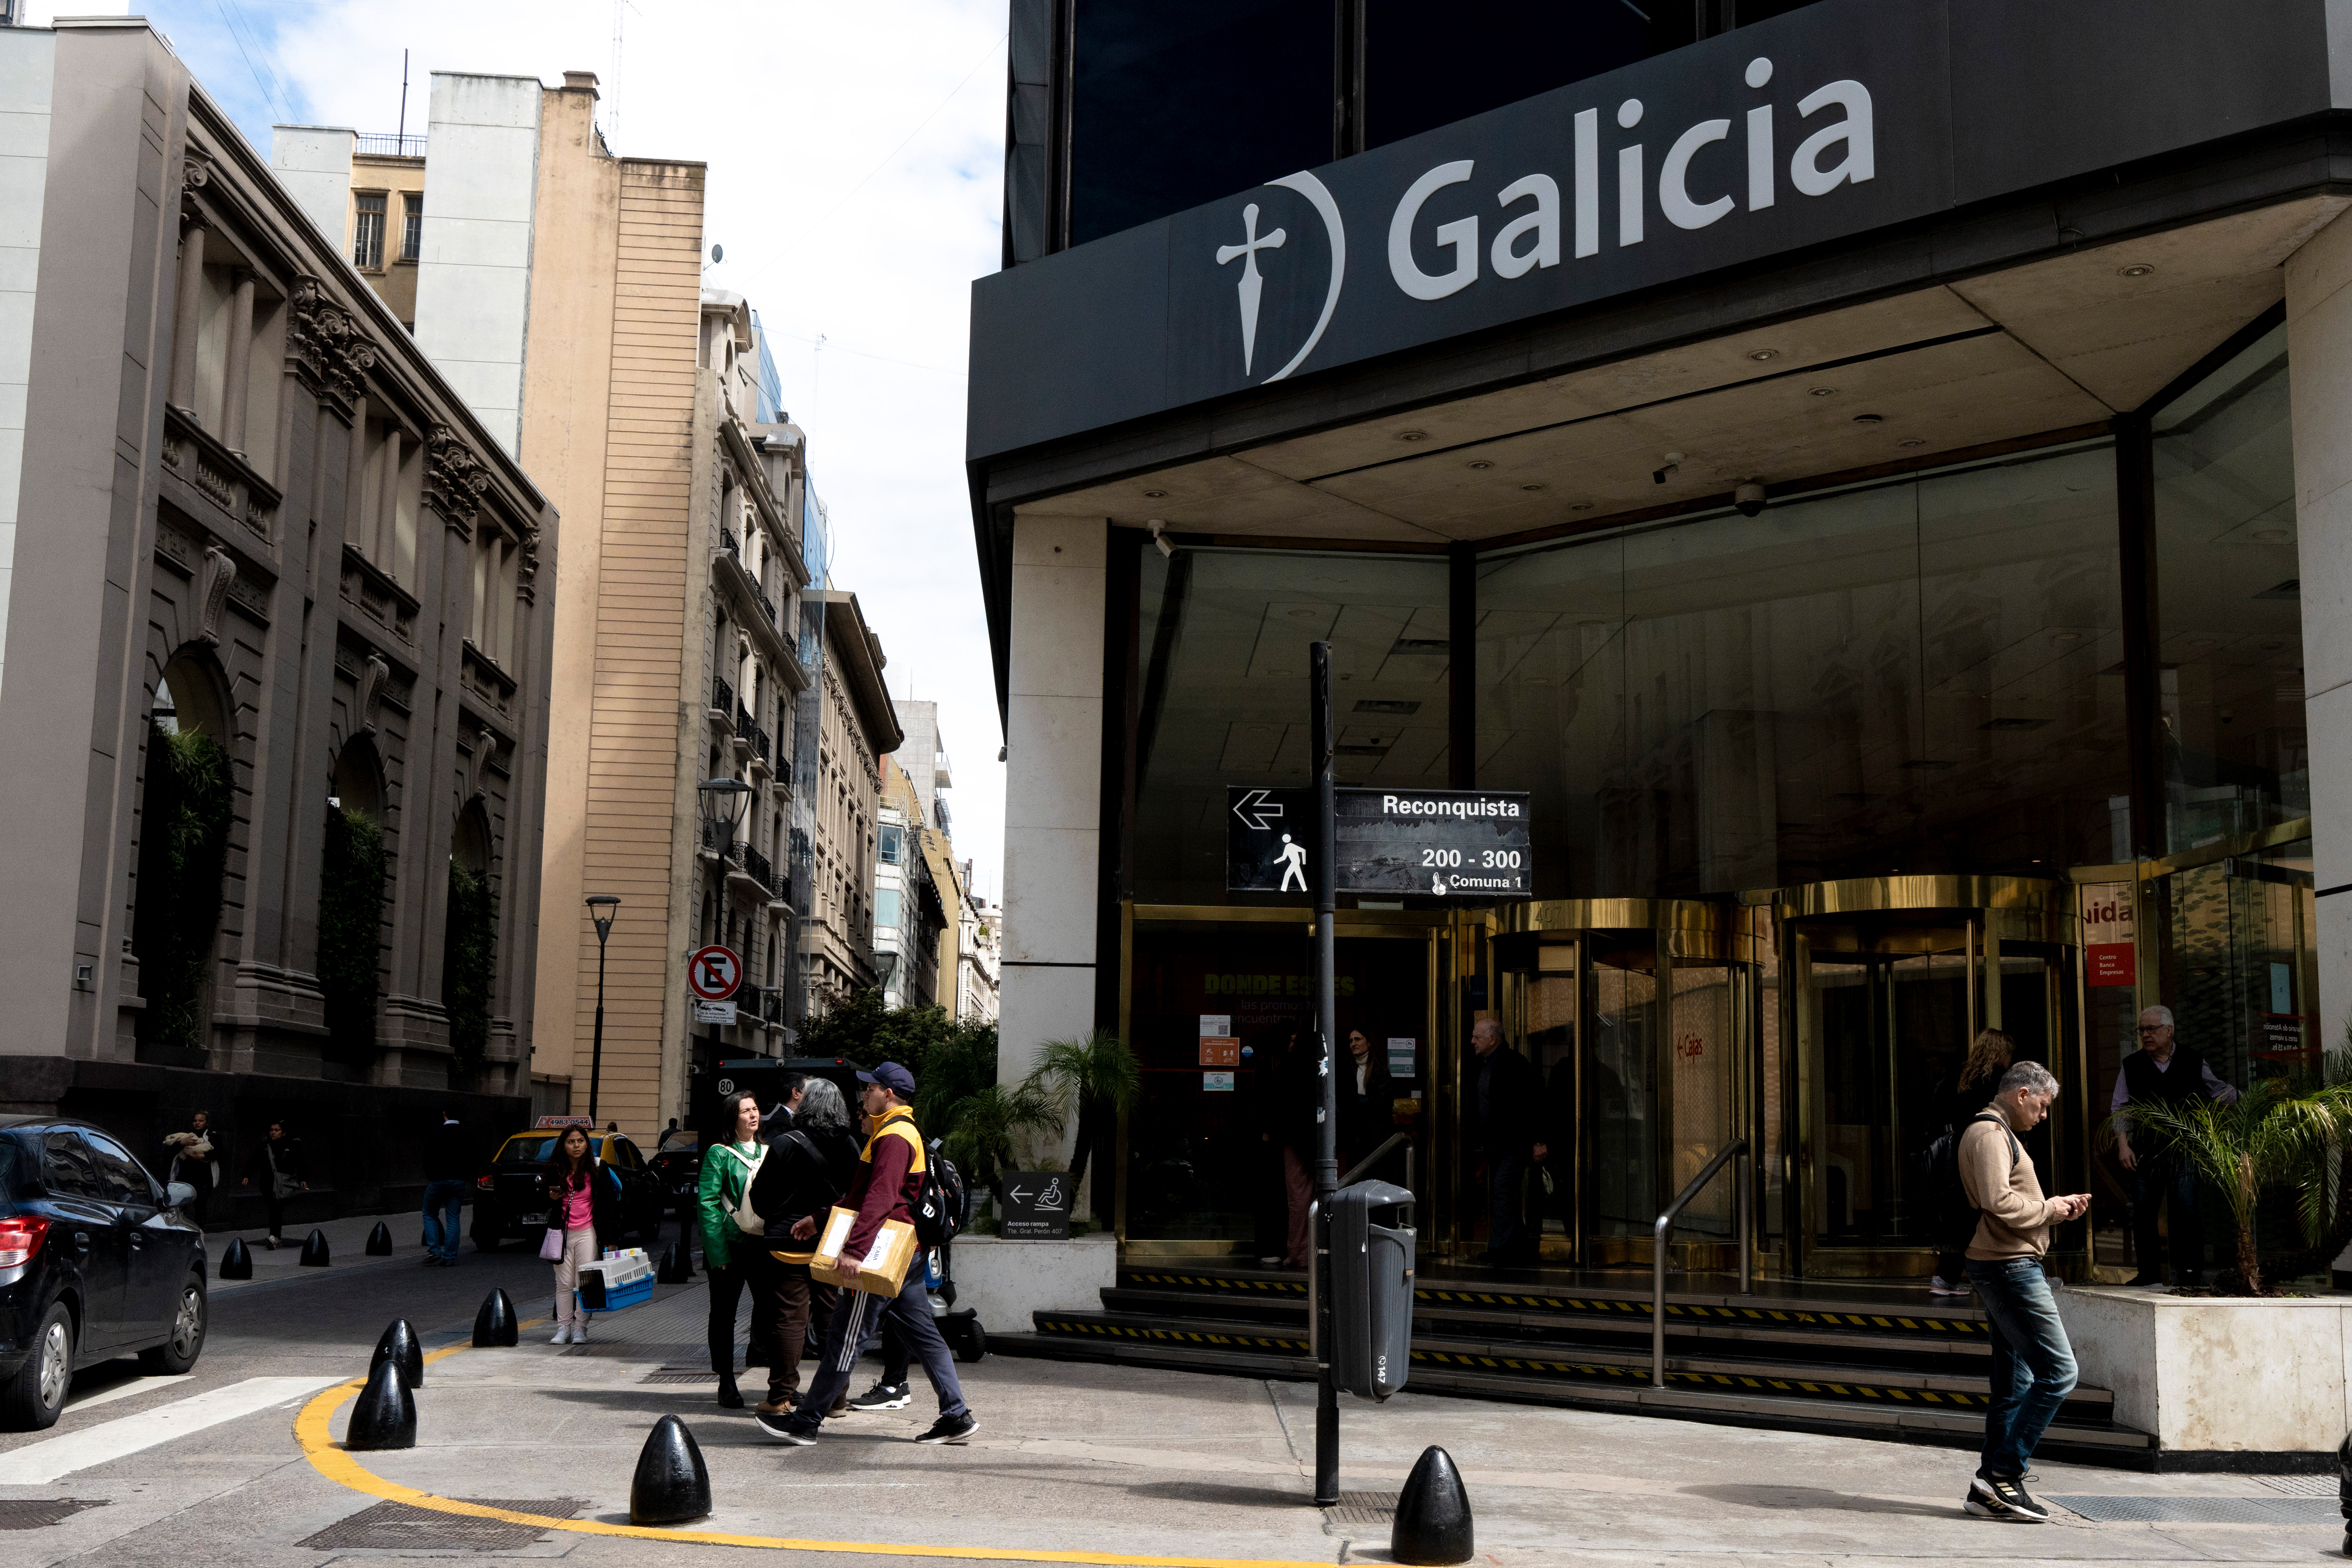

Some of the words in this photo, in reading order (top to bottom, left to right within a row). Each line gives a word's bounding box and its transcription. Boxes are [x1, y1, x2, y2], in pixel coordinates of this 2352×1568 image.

[1388, 57, 1875, 300] Galicia
[1383, 795, 1519, 820] Reconquista
[1422, 849, 1461, 867] 200
[1482, 850, 1521, 868] 300
[1450, 874, 1510, 888] Comuna
[1515, 876, 1521, 888] 1
[1535, 907, 1562, 923] 407
[1204, 974, 1282, 995] DONDE
[1286, 973, 1355, 996] ESS
[1241, 999, 1257, 1010] las
[1261, 1001, 1303, 1012] promos
[1685, 1032, 1702, 1065] Cajas
[721, 1081, 731, 1092] 80
[1377, 1366, 1386, 1384] 147
